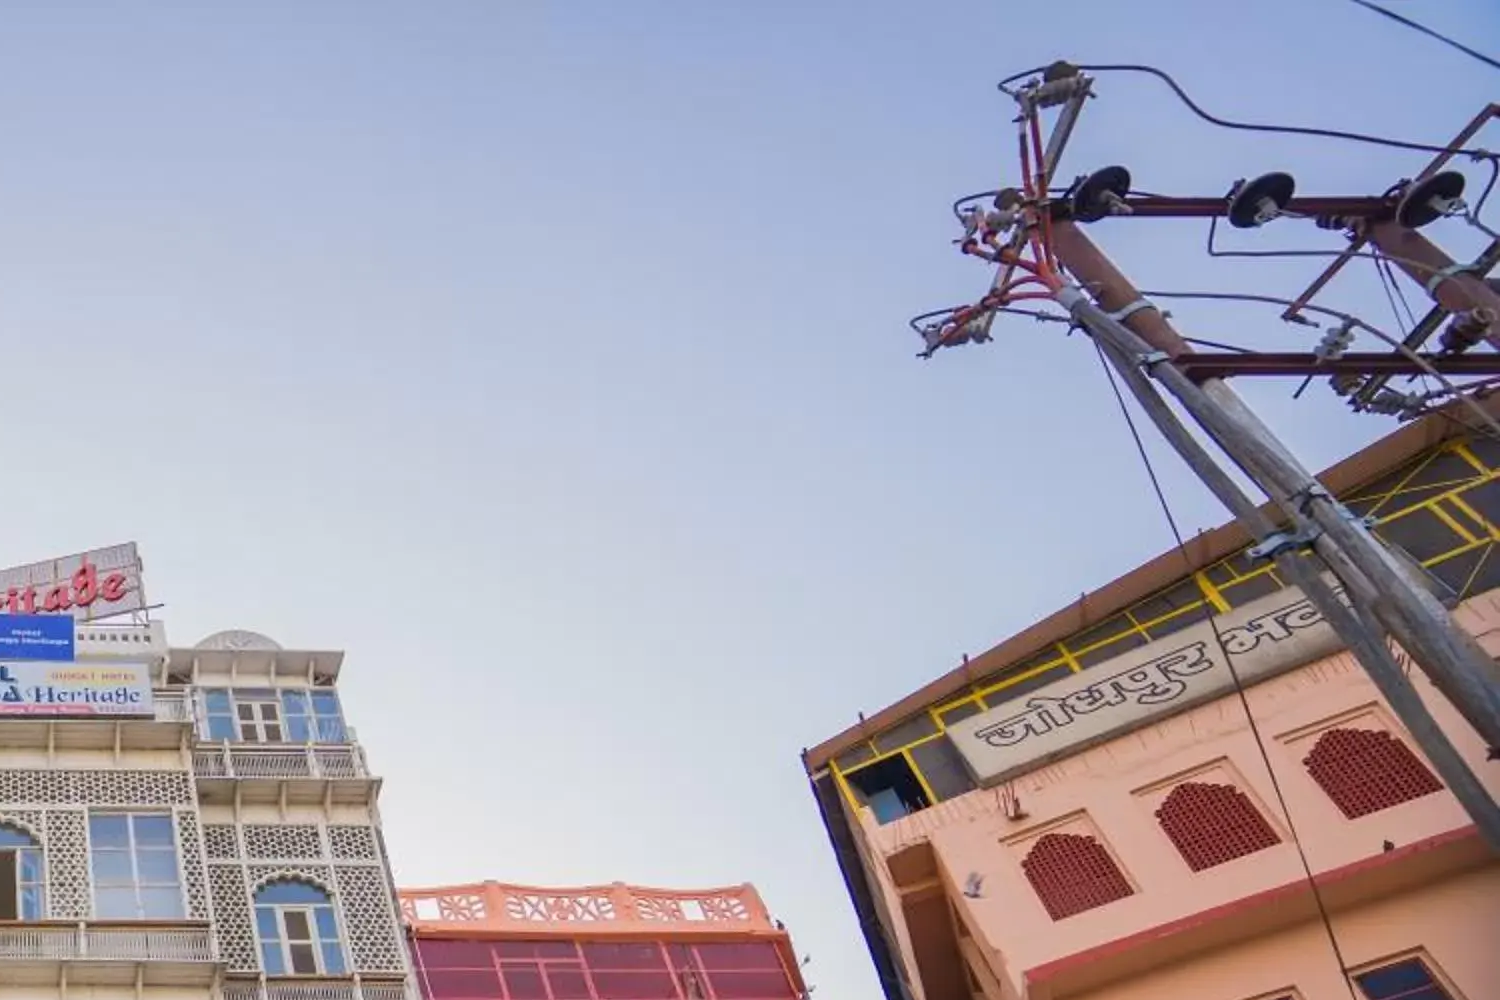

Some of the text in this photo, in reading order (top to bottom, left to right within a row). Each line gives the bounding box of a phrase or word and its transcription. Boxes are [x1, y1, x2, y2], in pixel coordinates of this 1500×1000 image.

[26, 684, 142, 706] Heritage
[975, 588, 1352, 748] जोधपुर भव
